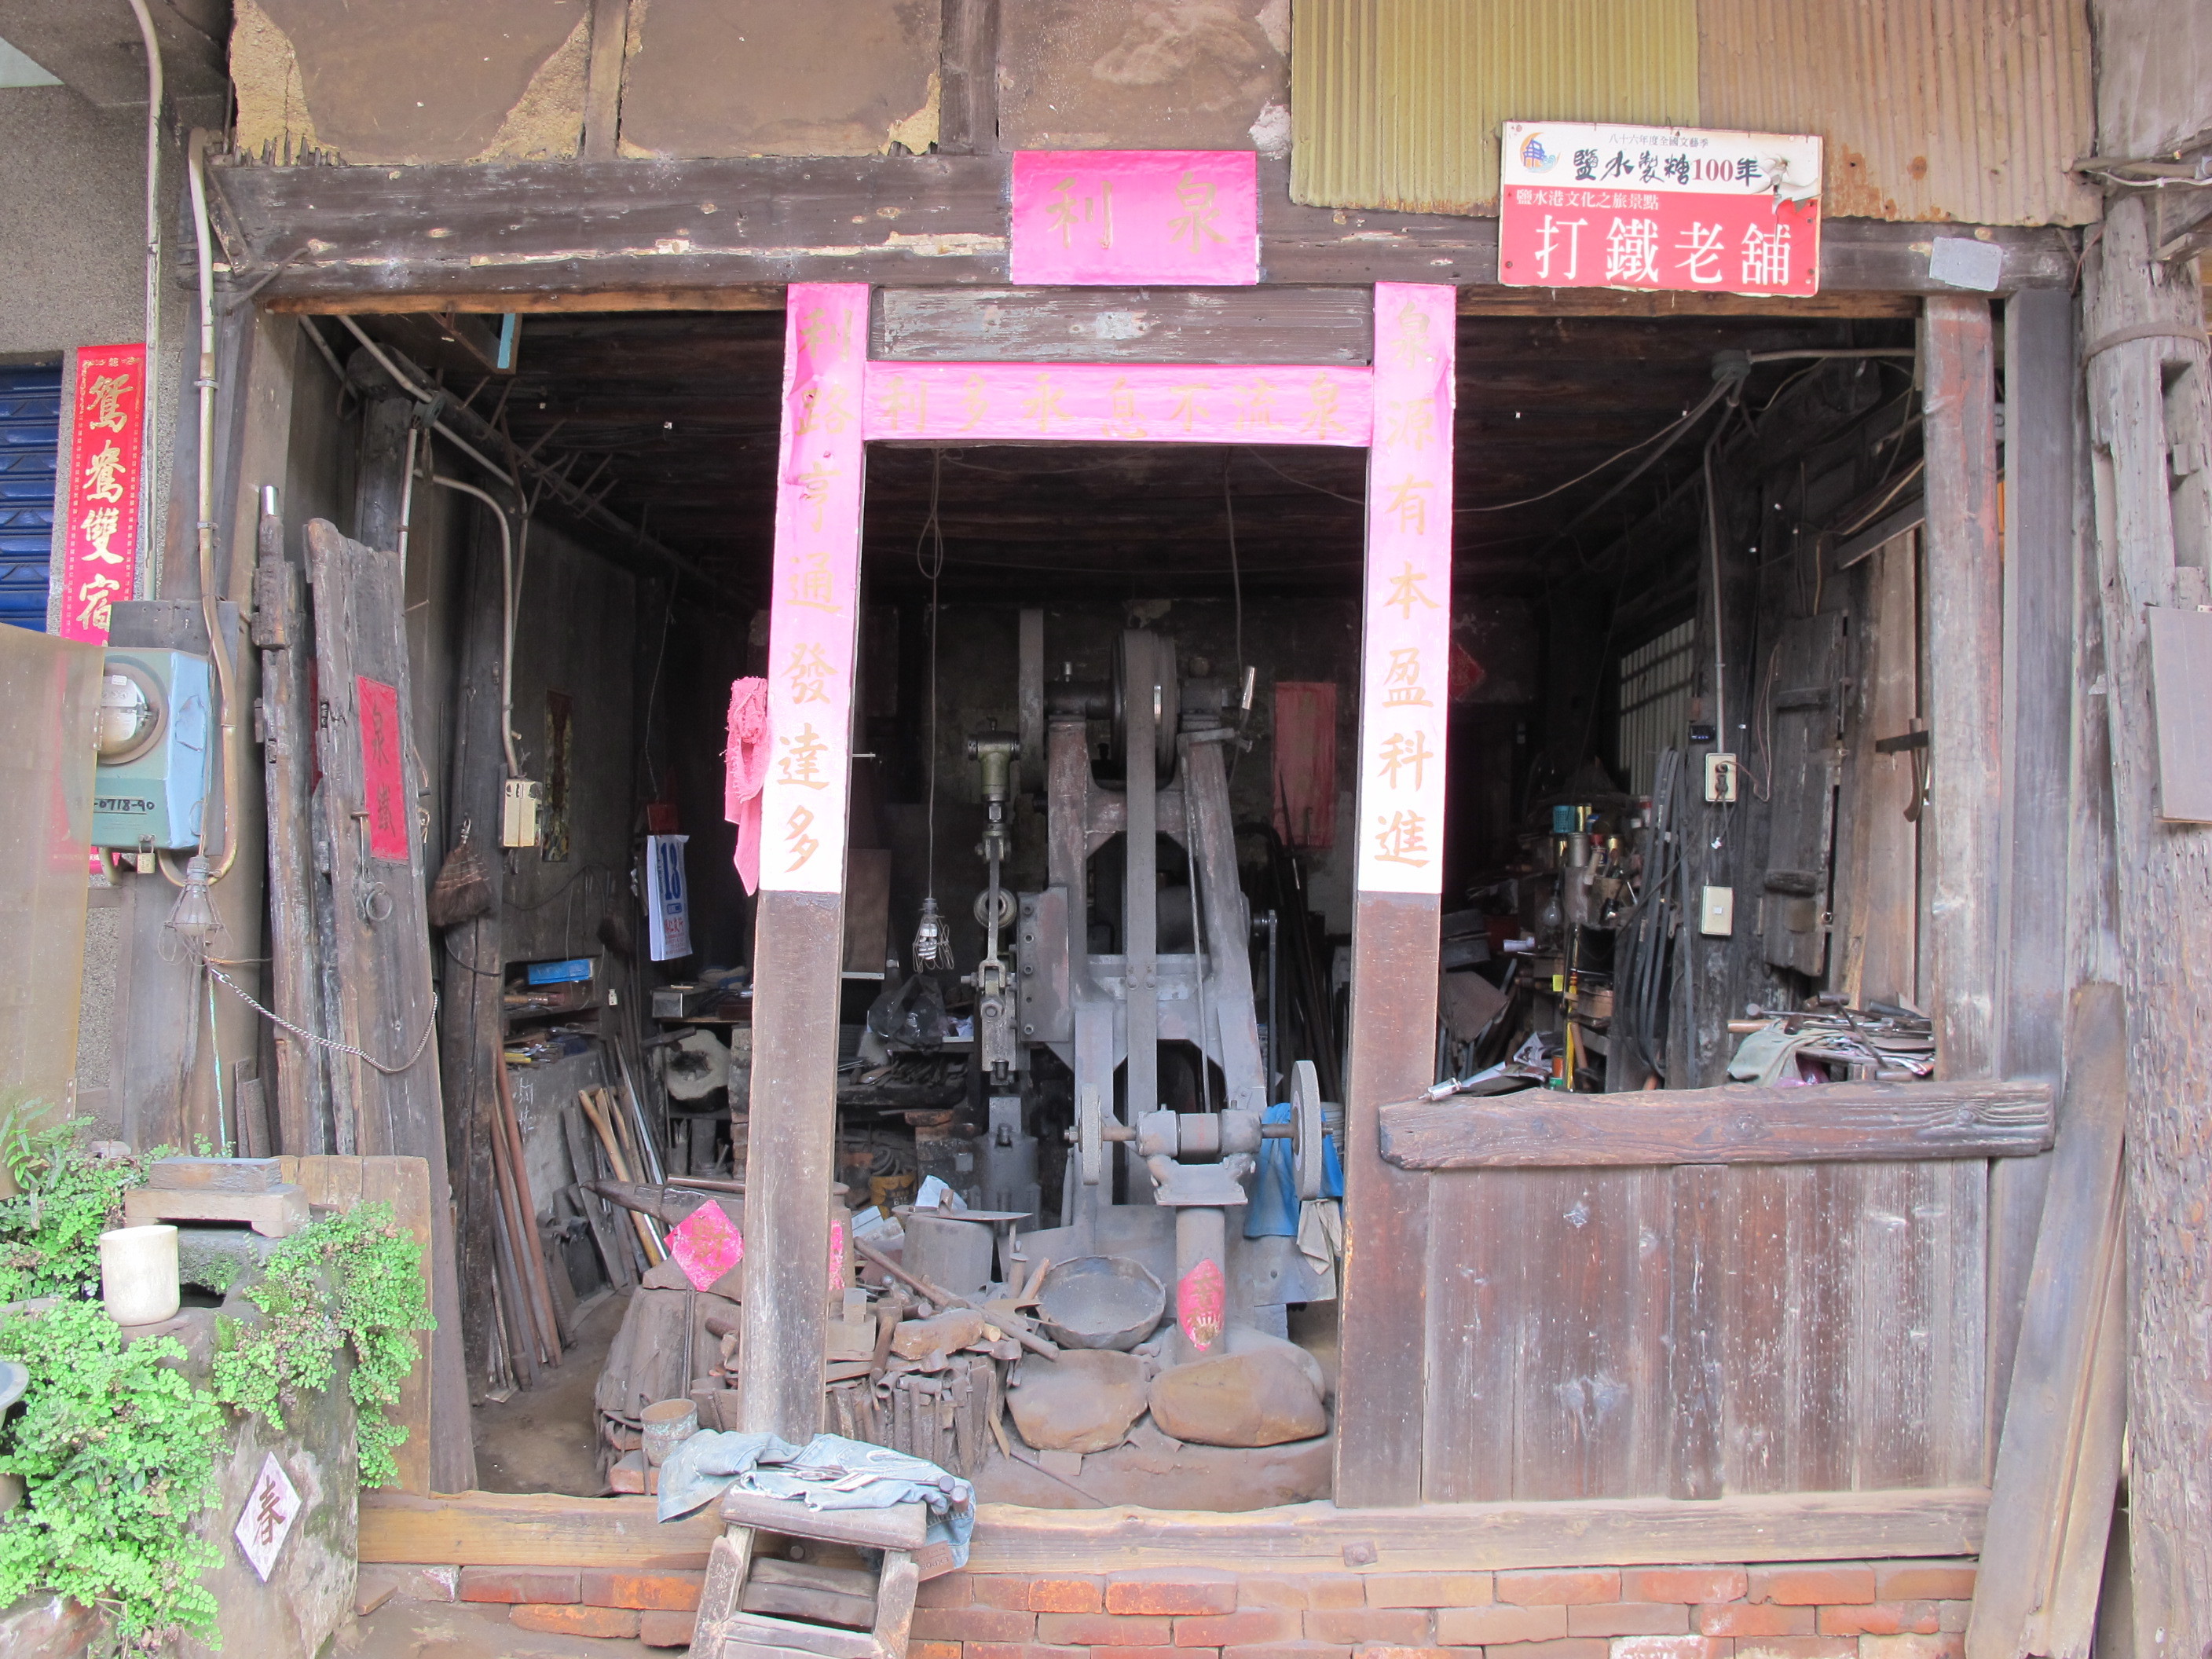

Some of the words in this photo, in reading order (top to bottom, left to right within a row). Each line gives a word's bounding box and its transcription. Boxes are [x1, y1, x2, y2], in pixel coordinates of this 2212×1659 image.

[1609, 134, 1708, 148] 八十六年度全國文藝季
[1516, 189, 1659, 210] 鹽水港文化之旅景點
[1534, 214, 1792, 286] 打鐵老舖
[1375, 302, 1441, 869] 泉源有本盈科進
[661, 842, 682, 900] 18
[253, 1474, 287, 1545] 春
